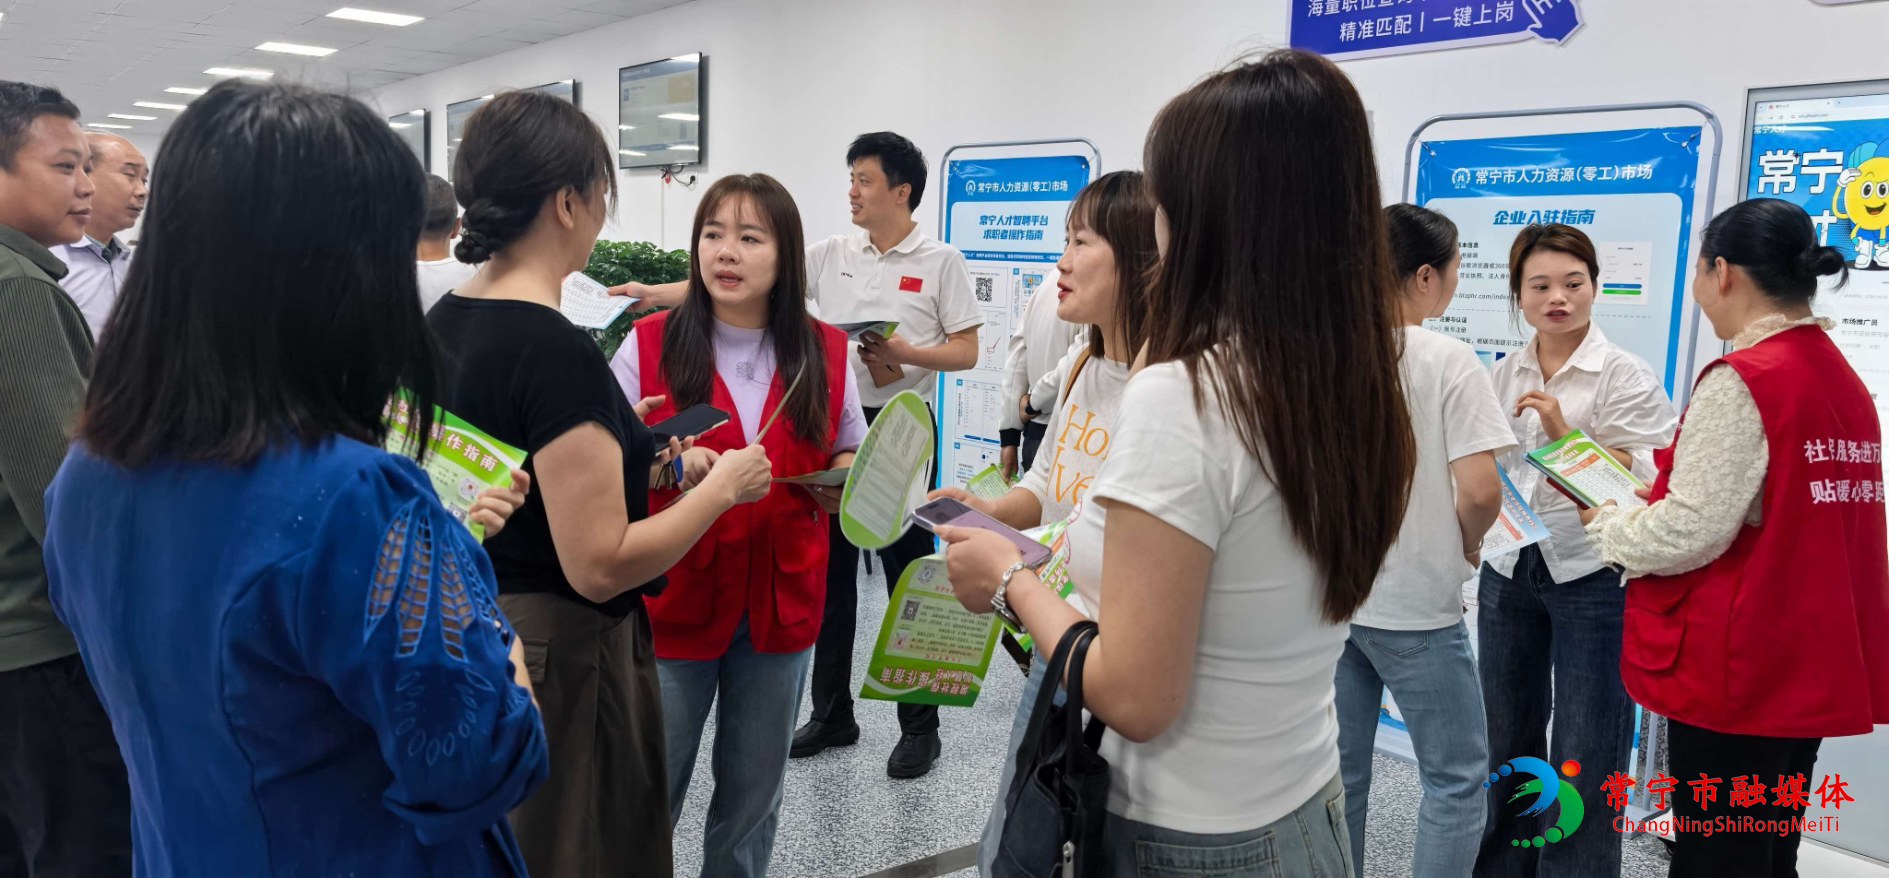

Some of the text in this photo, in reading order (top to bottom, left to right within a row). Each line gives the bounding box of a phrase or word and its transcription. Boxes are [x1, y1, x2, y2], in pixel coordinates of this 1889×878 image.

[1339, 14, 1412, 42] 精准匹配
[1432, 2, 1514, 28] 一键上岗
[1475, 164, 1653, 185] 常宁市人力资源(零工)市场
[1757, 148, 1844, 195] 常宁
[977, 180, 1068, 193] 常宁市人力资源(零工)市场
[979, 215, 1049, 227] 常宁人才智聘平台
[1492, 209, 1596, 226] 企业入驻指南
[983, 229, 1044, 241] 求职者操作指南
[1058, 404, 1109, 460] Ho
[880, 666, 931, 687] 操作指南
